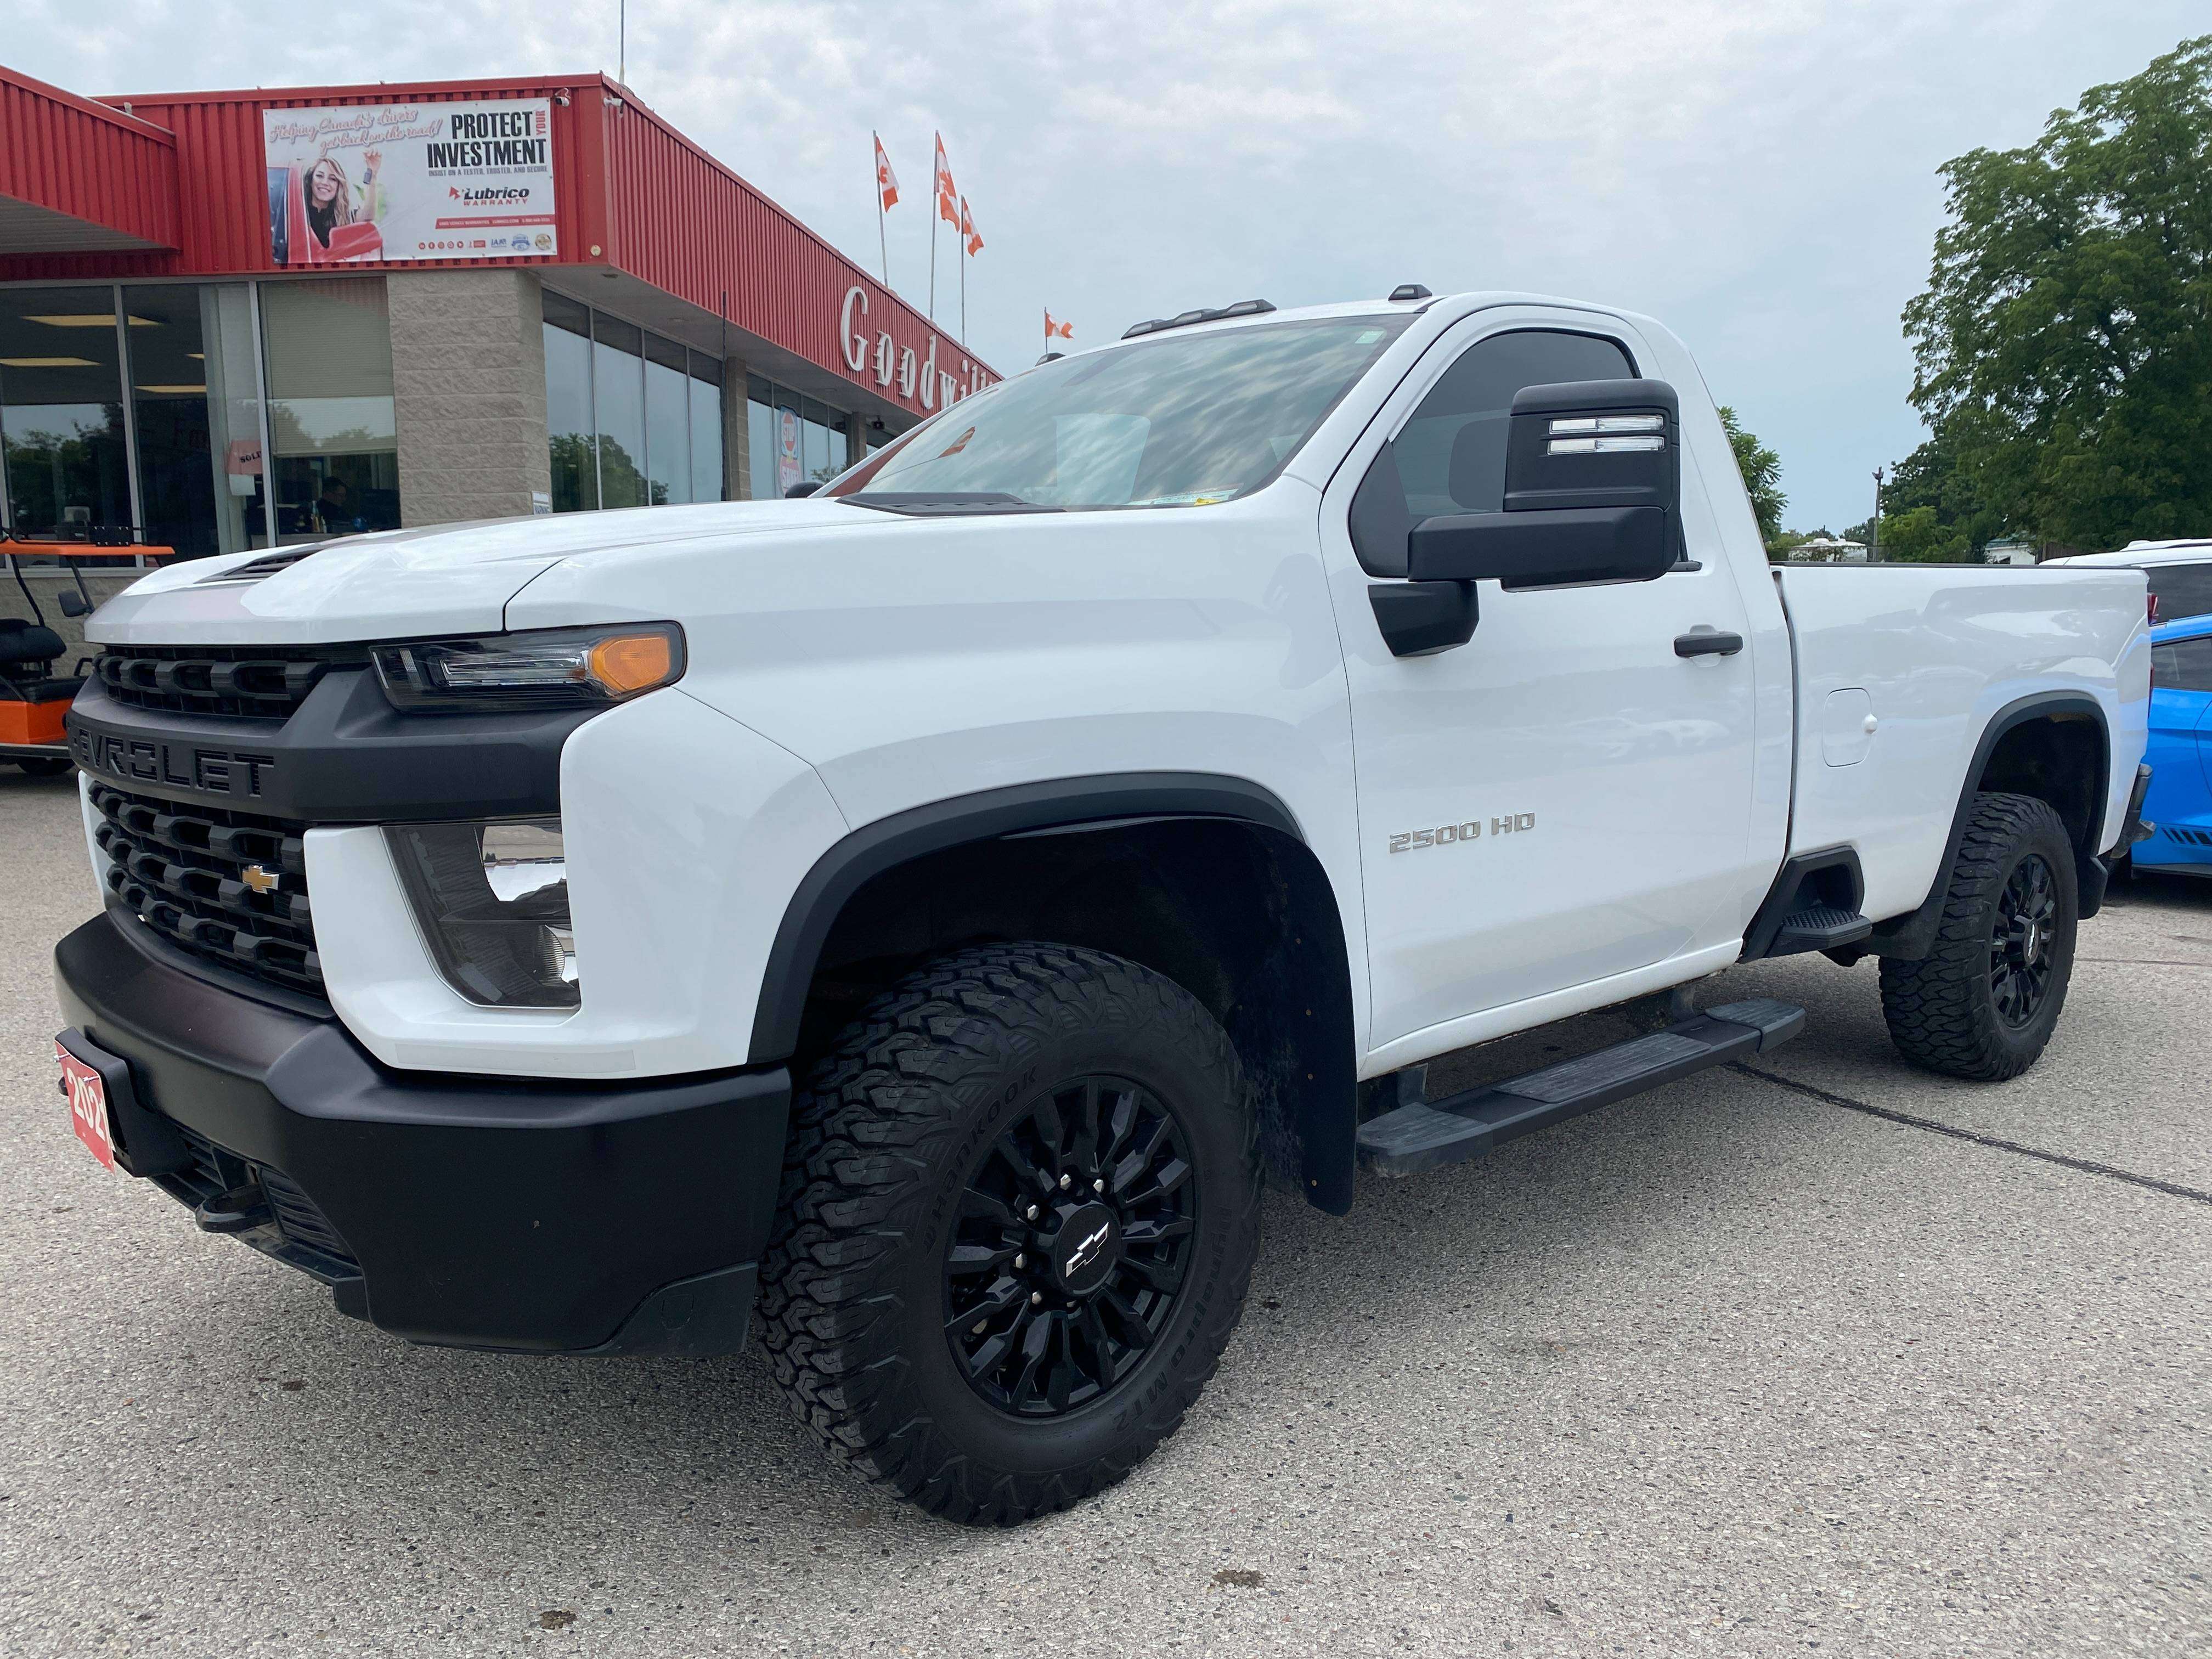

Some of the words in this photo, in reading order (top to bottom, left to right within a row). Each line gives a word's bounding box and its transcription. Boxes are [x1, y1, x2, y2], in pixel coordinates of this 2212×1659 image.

[269, 122, 317, 144] Helping
[319, 111, 374, 133] Canada's
[377, 108, 418, 125] drivers
[452, 111, 532, 139] PROTECT
[535, 111, 546, 135] YOUR
[320, 137, 339, 156] get
[338, 129, 369, 146] back
[369, 134, 384, 143] on
[384, 125, 404, 142] the
[427, 139, 546, 168] INVESTMENT
[464, 187, 529, 200] Lubrico
[73, 727, 275, 798] EVROLET
[1389, 820, 1481, 854] 2500
[1491, 811, 1535, 836] HD
